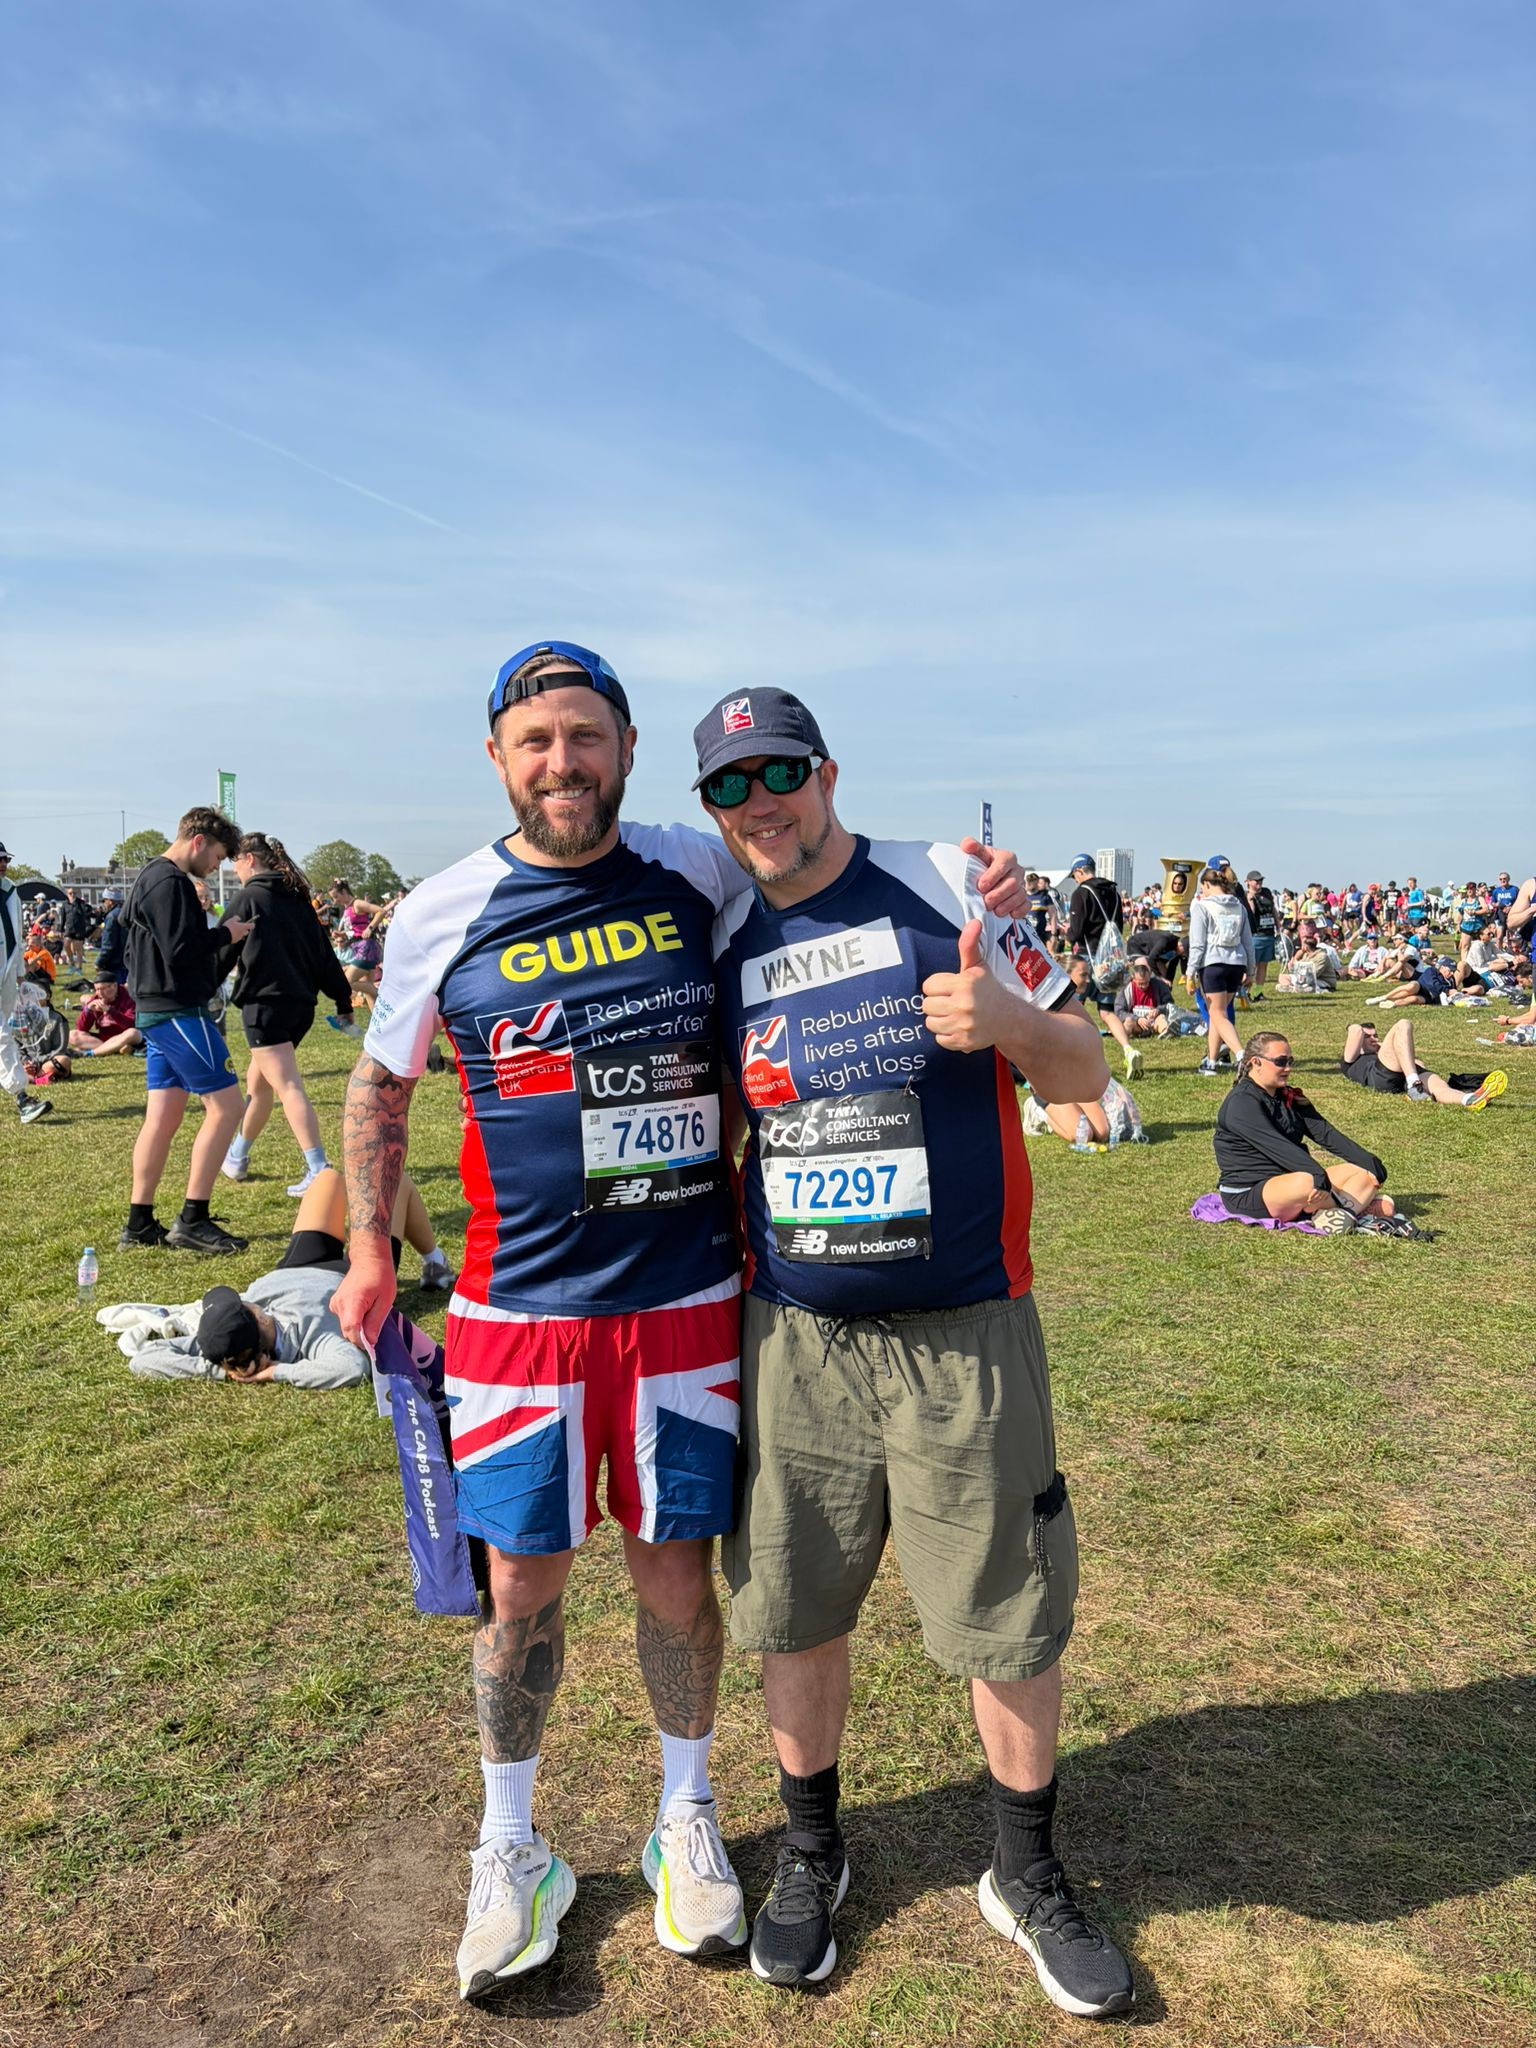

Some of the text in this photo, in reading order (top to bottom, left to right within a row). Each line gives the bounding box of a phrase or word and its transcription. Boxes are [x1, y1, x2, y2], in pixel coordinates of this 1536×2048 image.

[500, 911, 684, 983] GUIDE
[761, 936, 865, 993] WAYNE
[585, 982, 715, 1026] Rebuilding
[801, 994, 924, 1038] Rebuilding
[657, 1014, 708, 1037] after
[804, 1024, 923, 1064] lives after
[649, 1053, 679, 1066] TATA
[651, 1062, 710, 1079] CONSULTANCY
[809, 1053, 927, 1092] sight loss
[503, 1080, 523, 1094] UK
[587, 1063, 646, 1098] tcs
[652, 1077, 694, 1093] SERVICES
[826, 1105, 862, 1119] TATA
[826, 1113, 911, 1132] CONSULTANCY
[612, 1110, 705, 1159] 74876
[826, 1129, 881, 1145] SERVICES
[653, 1181, 714, 1202] new balance
[785, 1164, 898, 1209] 72297
[830, 1237, 917, 1255] new balance
[406, 1397, 419, 1426] The
[420, 1478, 440, 1540] Podcast
